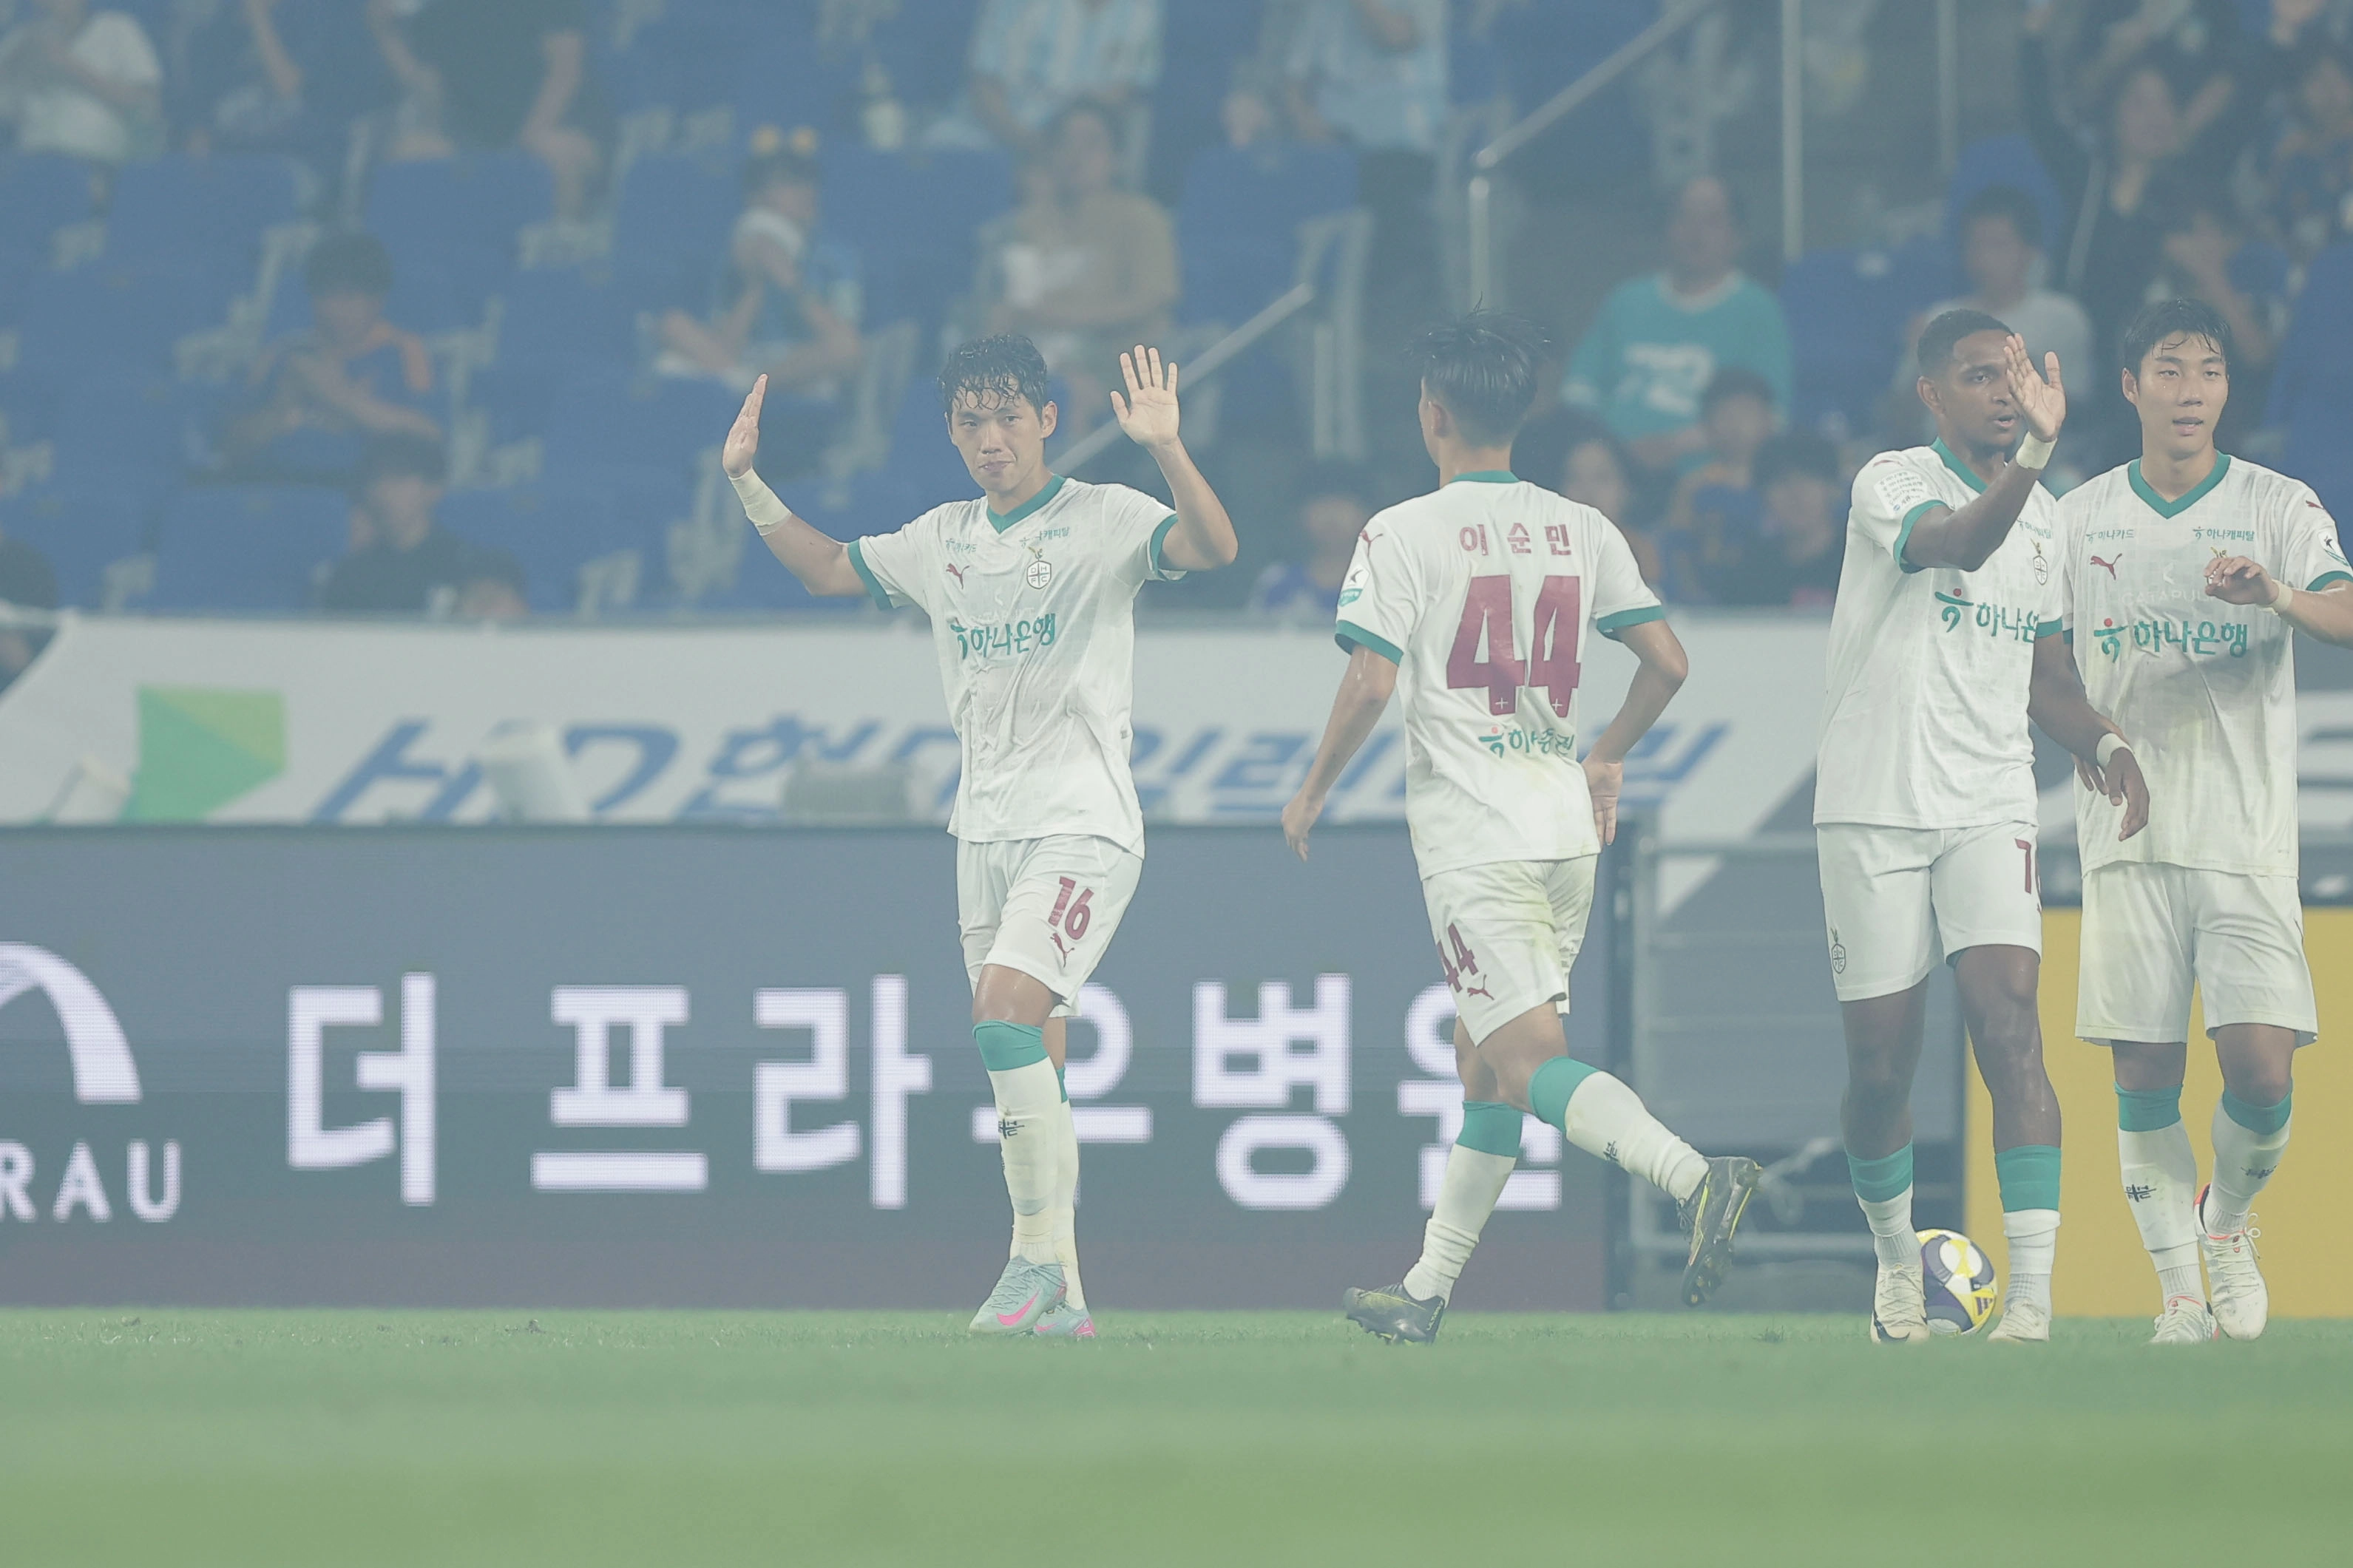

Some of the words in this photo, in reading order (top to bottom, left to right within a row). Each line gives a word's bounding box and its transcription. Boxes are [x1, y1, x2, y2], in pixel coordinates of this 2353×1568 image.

[1035, 526, 1070, 540] 나캐피탈
[1459, 523, 1573, 556] 이순민
[970, 613, 1056, 658] 하나은행
[1976, 602, 2039, 643] 하나은
[2134, 621, 2249, 658] 하나은행
[1446, 574, 1581, 718] 44
[1048, 876, 1094, 940] 16
